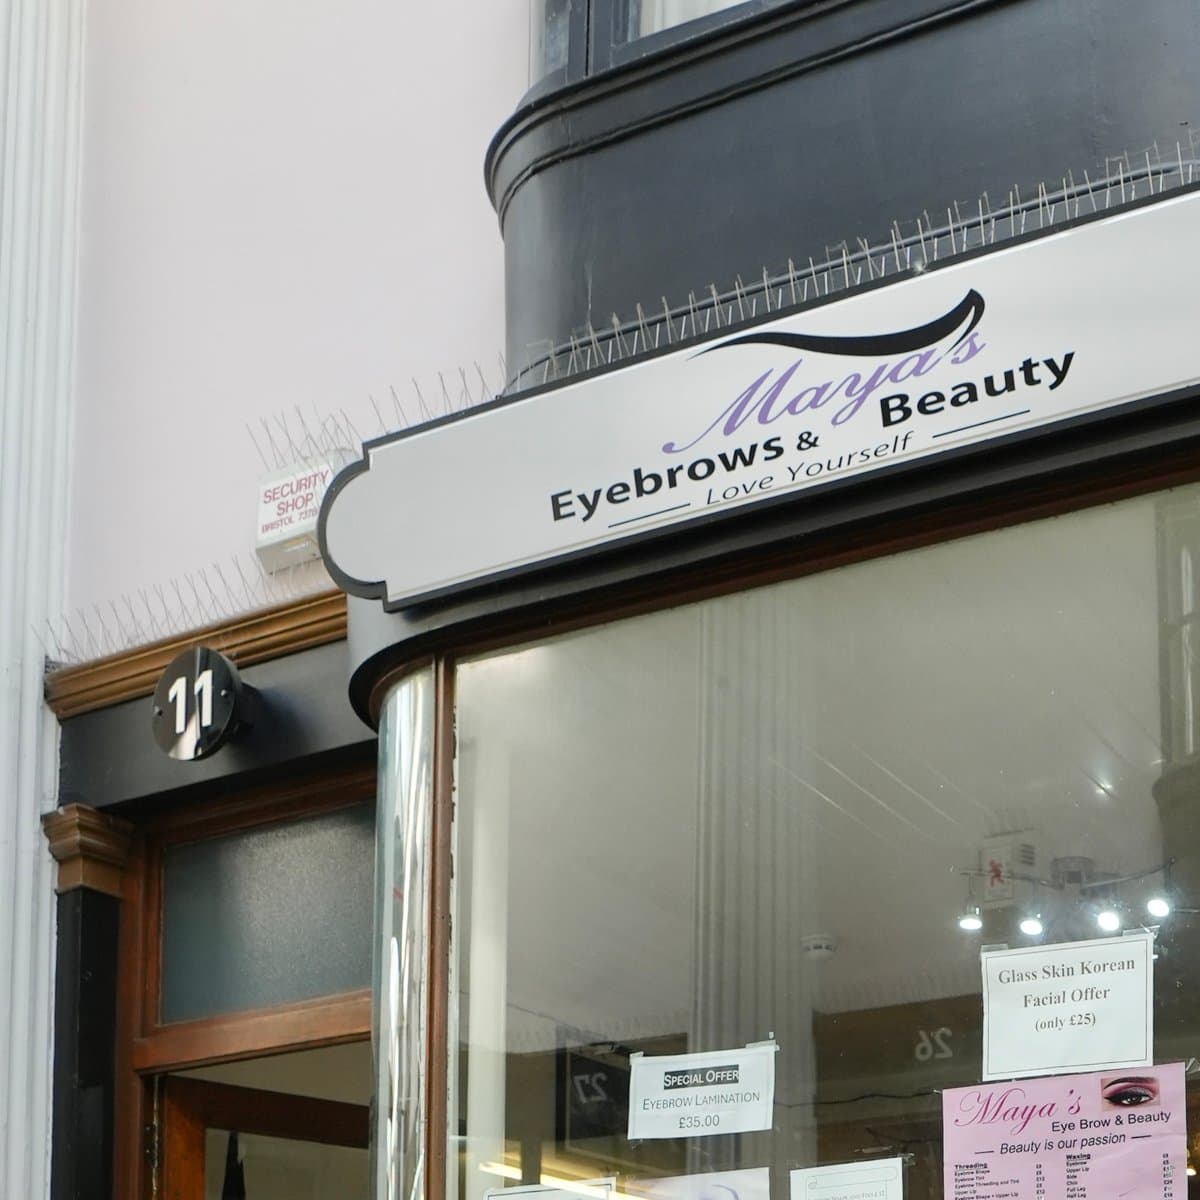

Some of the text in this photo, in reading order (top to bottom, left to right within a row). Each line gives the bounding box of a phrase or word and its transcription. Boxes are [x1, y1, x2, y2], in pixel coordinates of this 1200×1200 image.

[662, 329, 986, 454] Maya's
[551, 351, 1075, 524] Eyebrows & Beauty
[706, 432, 915, 506] Love Yourself
[264, 470, 329, 504] SECURITY
[277, 492, 314, 516] SHOP
[168, 669, 213, 734] 11
[998, 959, 1135, 984] Glass Skin Korean
[1024, 987, 1110, 1008] Facial Offer
[1035, 1012, 1096, 1032] (only £25)
[664, 1074, 704, 1087] SPECIAL
[642, 1092, 760, 1111] EYEBROW LAMINATION
[954, 1088, 1081, 1136] Maya's
[679, 1114, 720, 1128] £35.00
[1052, 1112, 1171, 1134] Eye Brow & Beauty
[1000, 1133, 1126, 1155] Beauty is our passion
